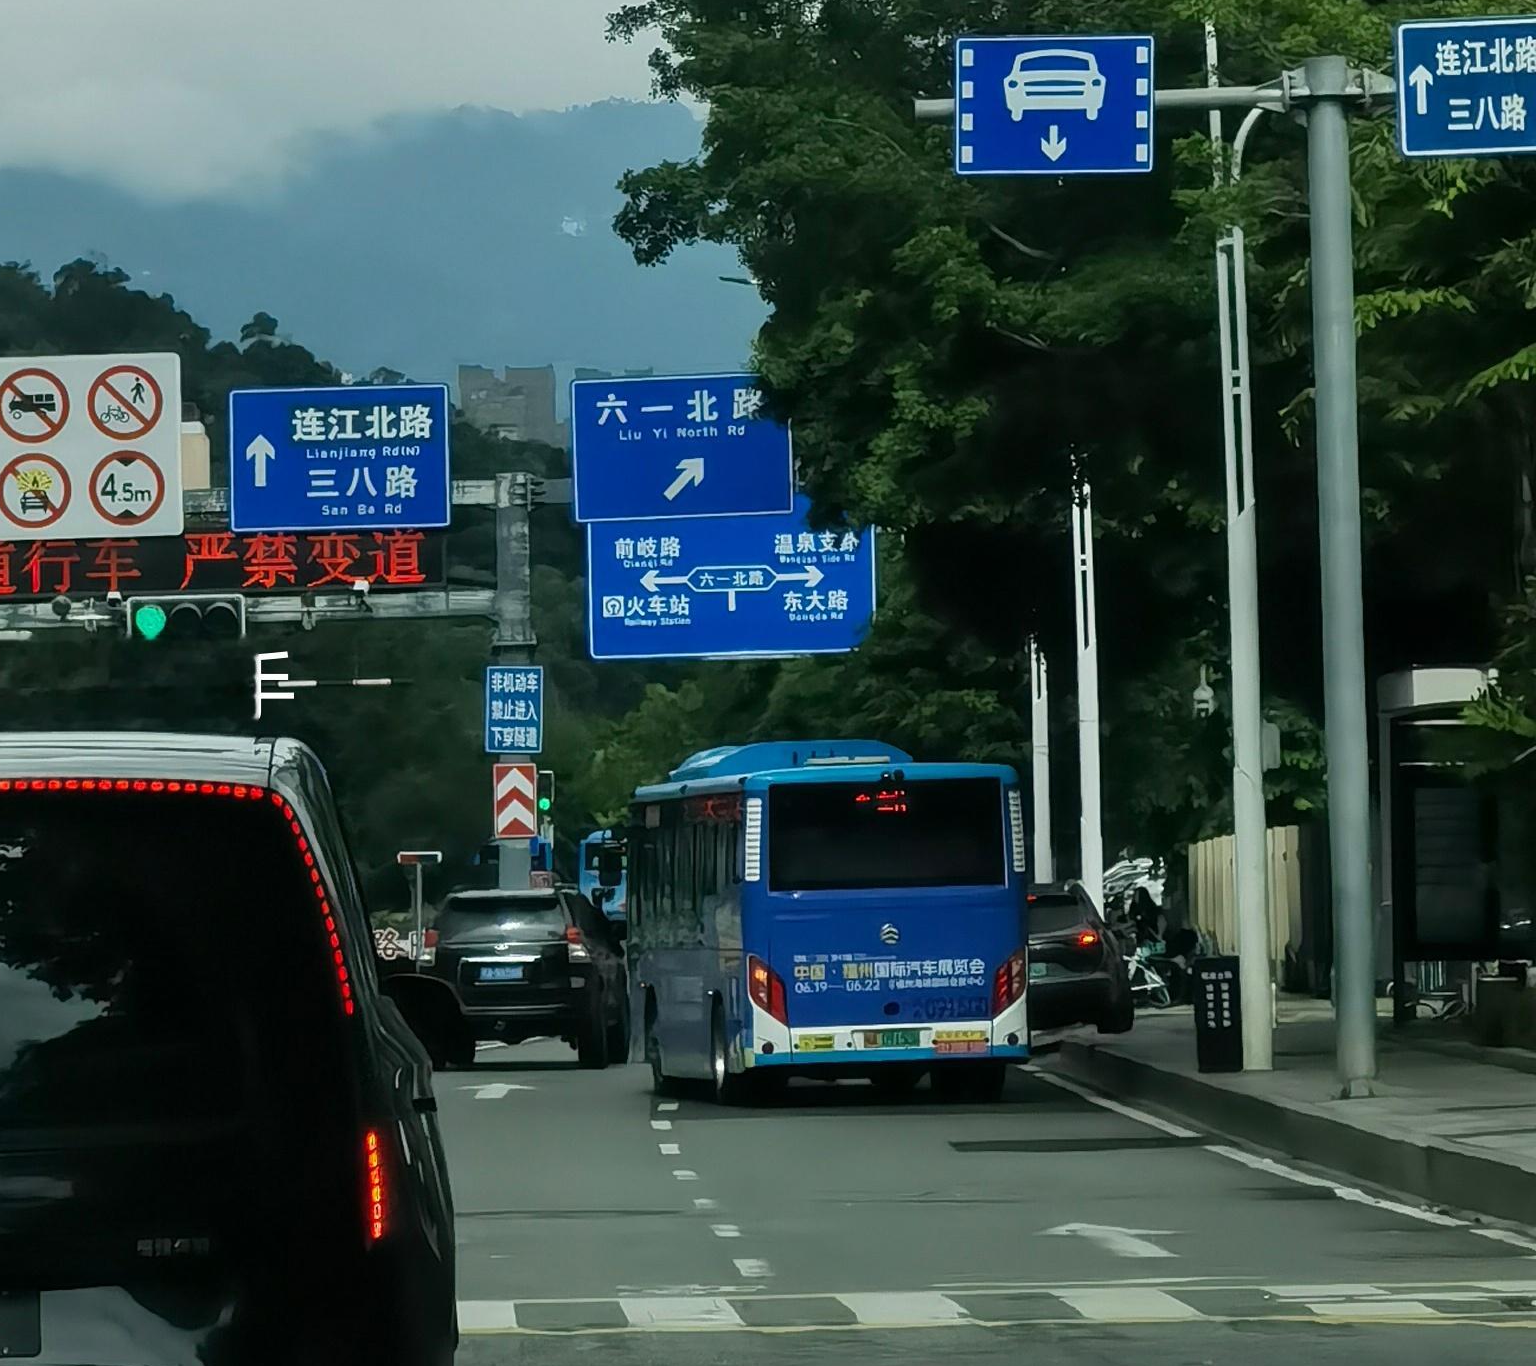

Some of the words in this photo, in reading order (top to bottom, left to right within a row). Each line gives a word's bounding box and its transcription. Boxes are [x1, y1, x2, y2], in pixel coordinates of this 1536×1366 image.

[1435, 35, 1536, 76] 连江北路
[1448, 93, 1527, 131] 三八路
[596, 387, 766, 426] 六一北路
[292, 404, 433, 441] 连江北路
[619, 429, 642, 440] Liu
[652, 428, 667, 439] Yi
[676, 426, 718, 437] North
[727, 425, 746, 435] Rd
[306, 446, 376, 460] Lianjiang
[382, 445, 420, 457] Rd(N)
[101, 473, 151, 502] 4.5m
[306, 464, 418, 498] 三八路
[321, 504, 348, 515] San
[357, 504, 376, 515] Ba
[384, 503, 402, 514] Rd
[179, 530, 426, 591] 严禁变道
[699, 570, 764, 587] 六一北路
[626, 593, 690, 616] 火车站
[783, 589, 848, 612] 东大路
